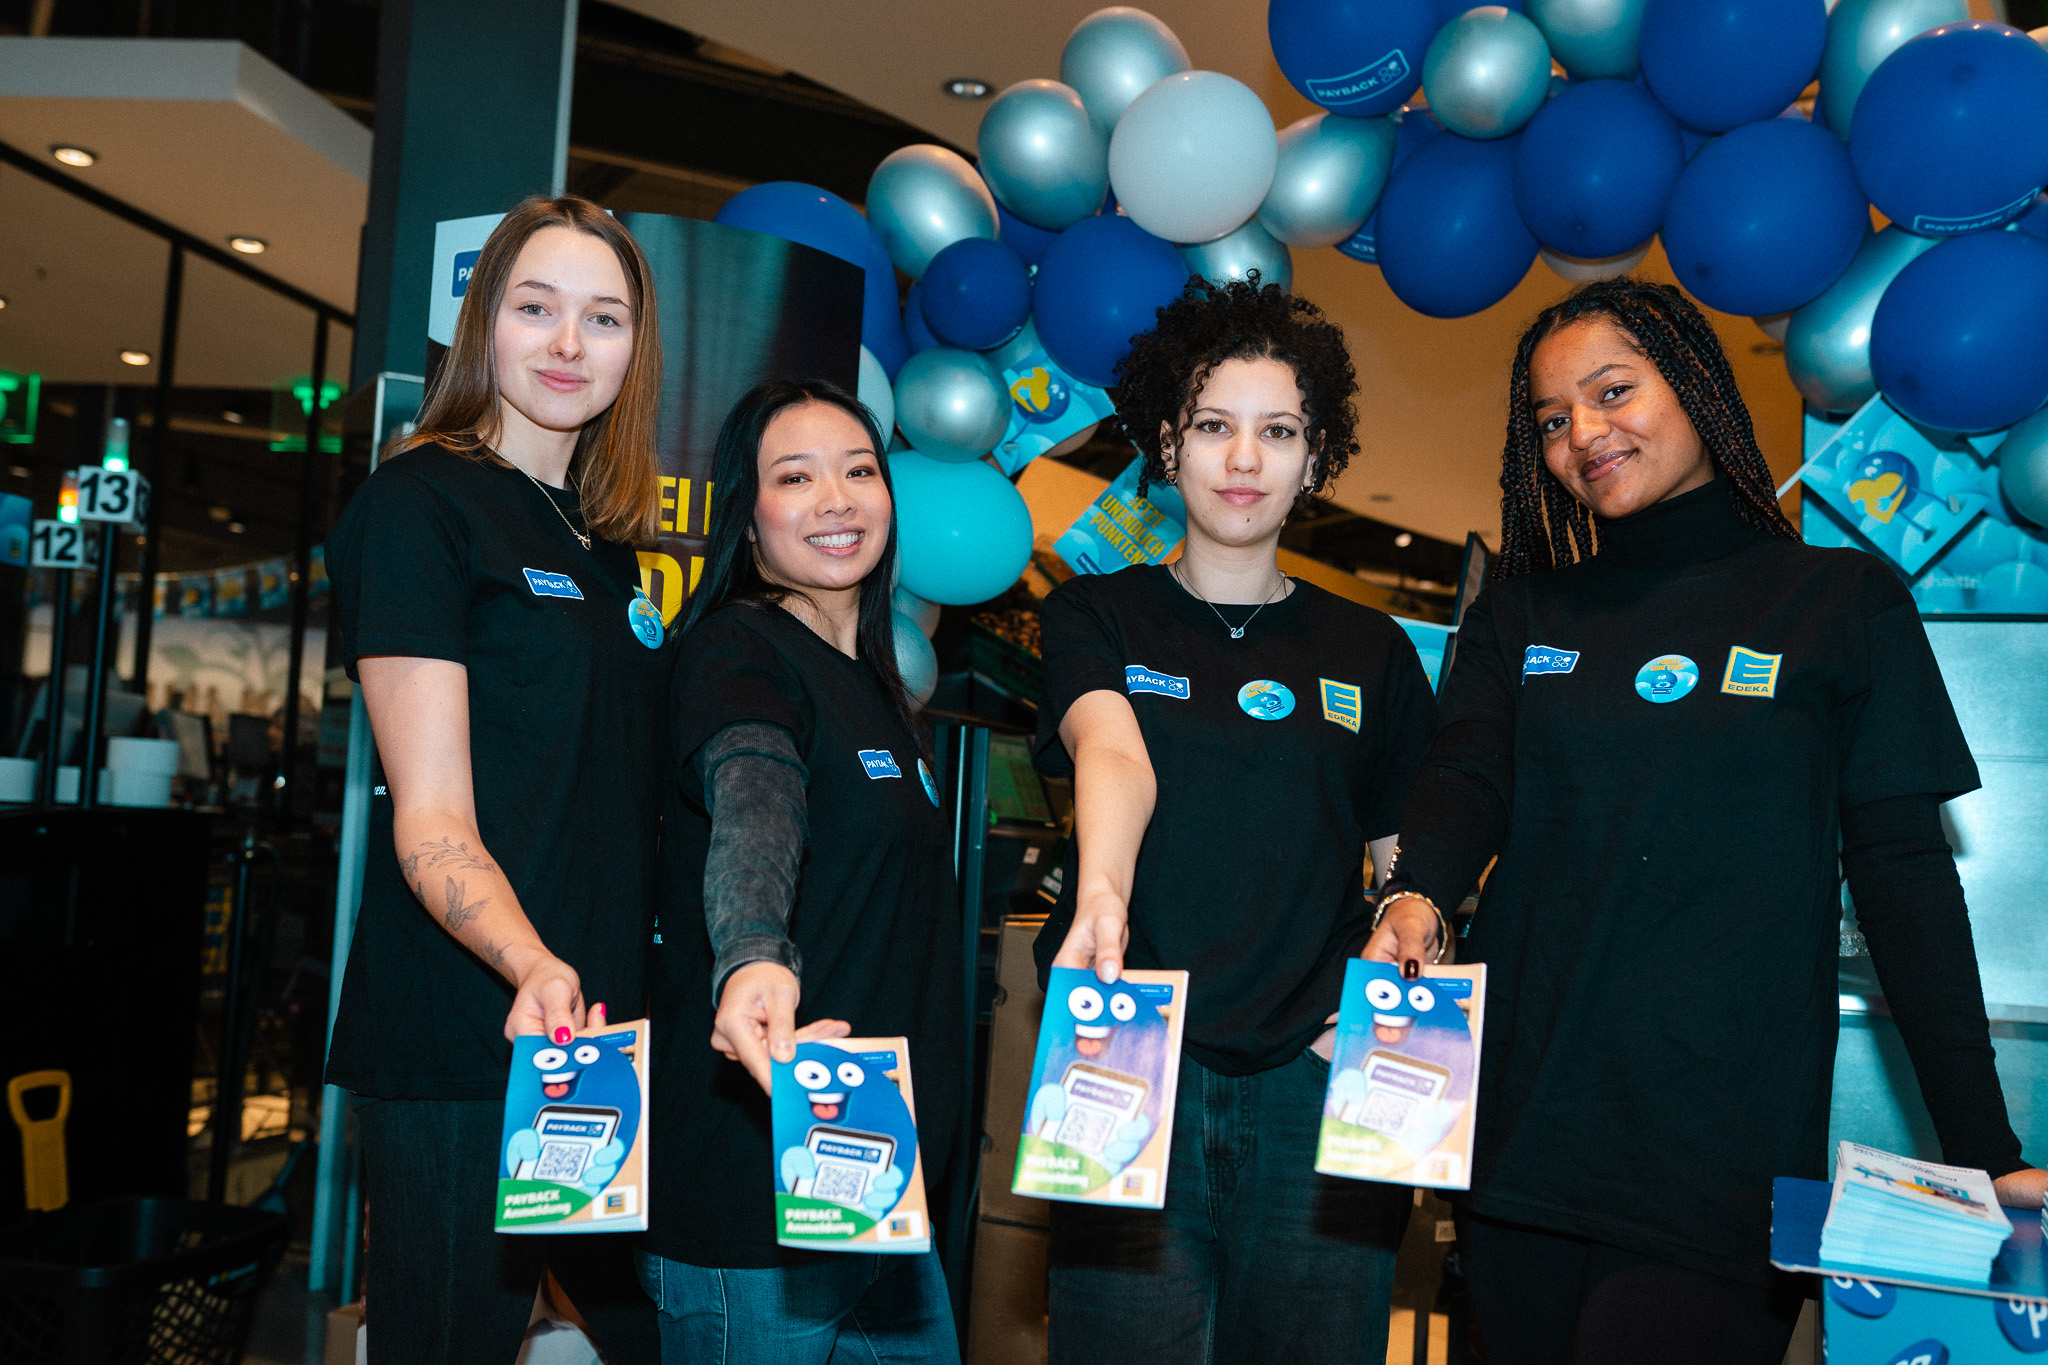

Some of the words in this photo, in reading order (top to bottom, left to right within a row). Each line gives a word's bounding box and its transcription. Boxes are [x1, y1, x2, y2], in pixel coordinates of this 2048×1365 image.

[1317, 77, 1378, 98] PAYBACK
[458, 266, 475, 281] PA
[81, 473, 129, 514] 13
[657, 475, 691, 533] EI
[1101, 494, 1166, 558] UNENDLICH
[35, 526, 77, 561] 12
[1089, 511, 1149, 565] PUNKTEN!
[1126, 674, 1166, 687] AYBACK
[1727, 684, 1769, 692] EDEKA
[1327, 712, 1357, 727] EDEKA
[546, 1122, 587, 1134] PAYBACK
[819, 1142, 862, 1158] PAYBACK
[505, 1189, 560, 1206] PAYBACK
[503, 1202, 572, 1219] Anmeldung
[785, 1208, 843, 1222] PAYBACK
[785, 1221, 856, 1236] Anmeldung
